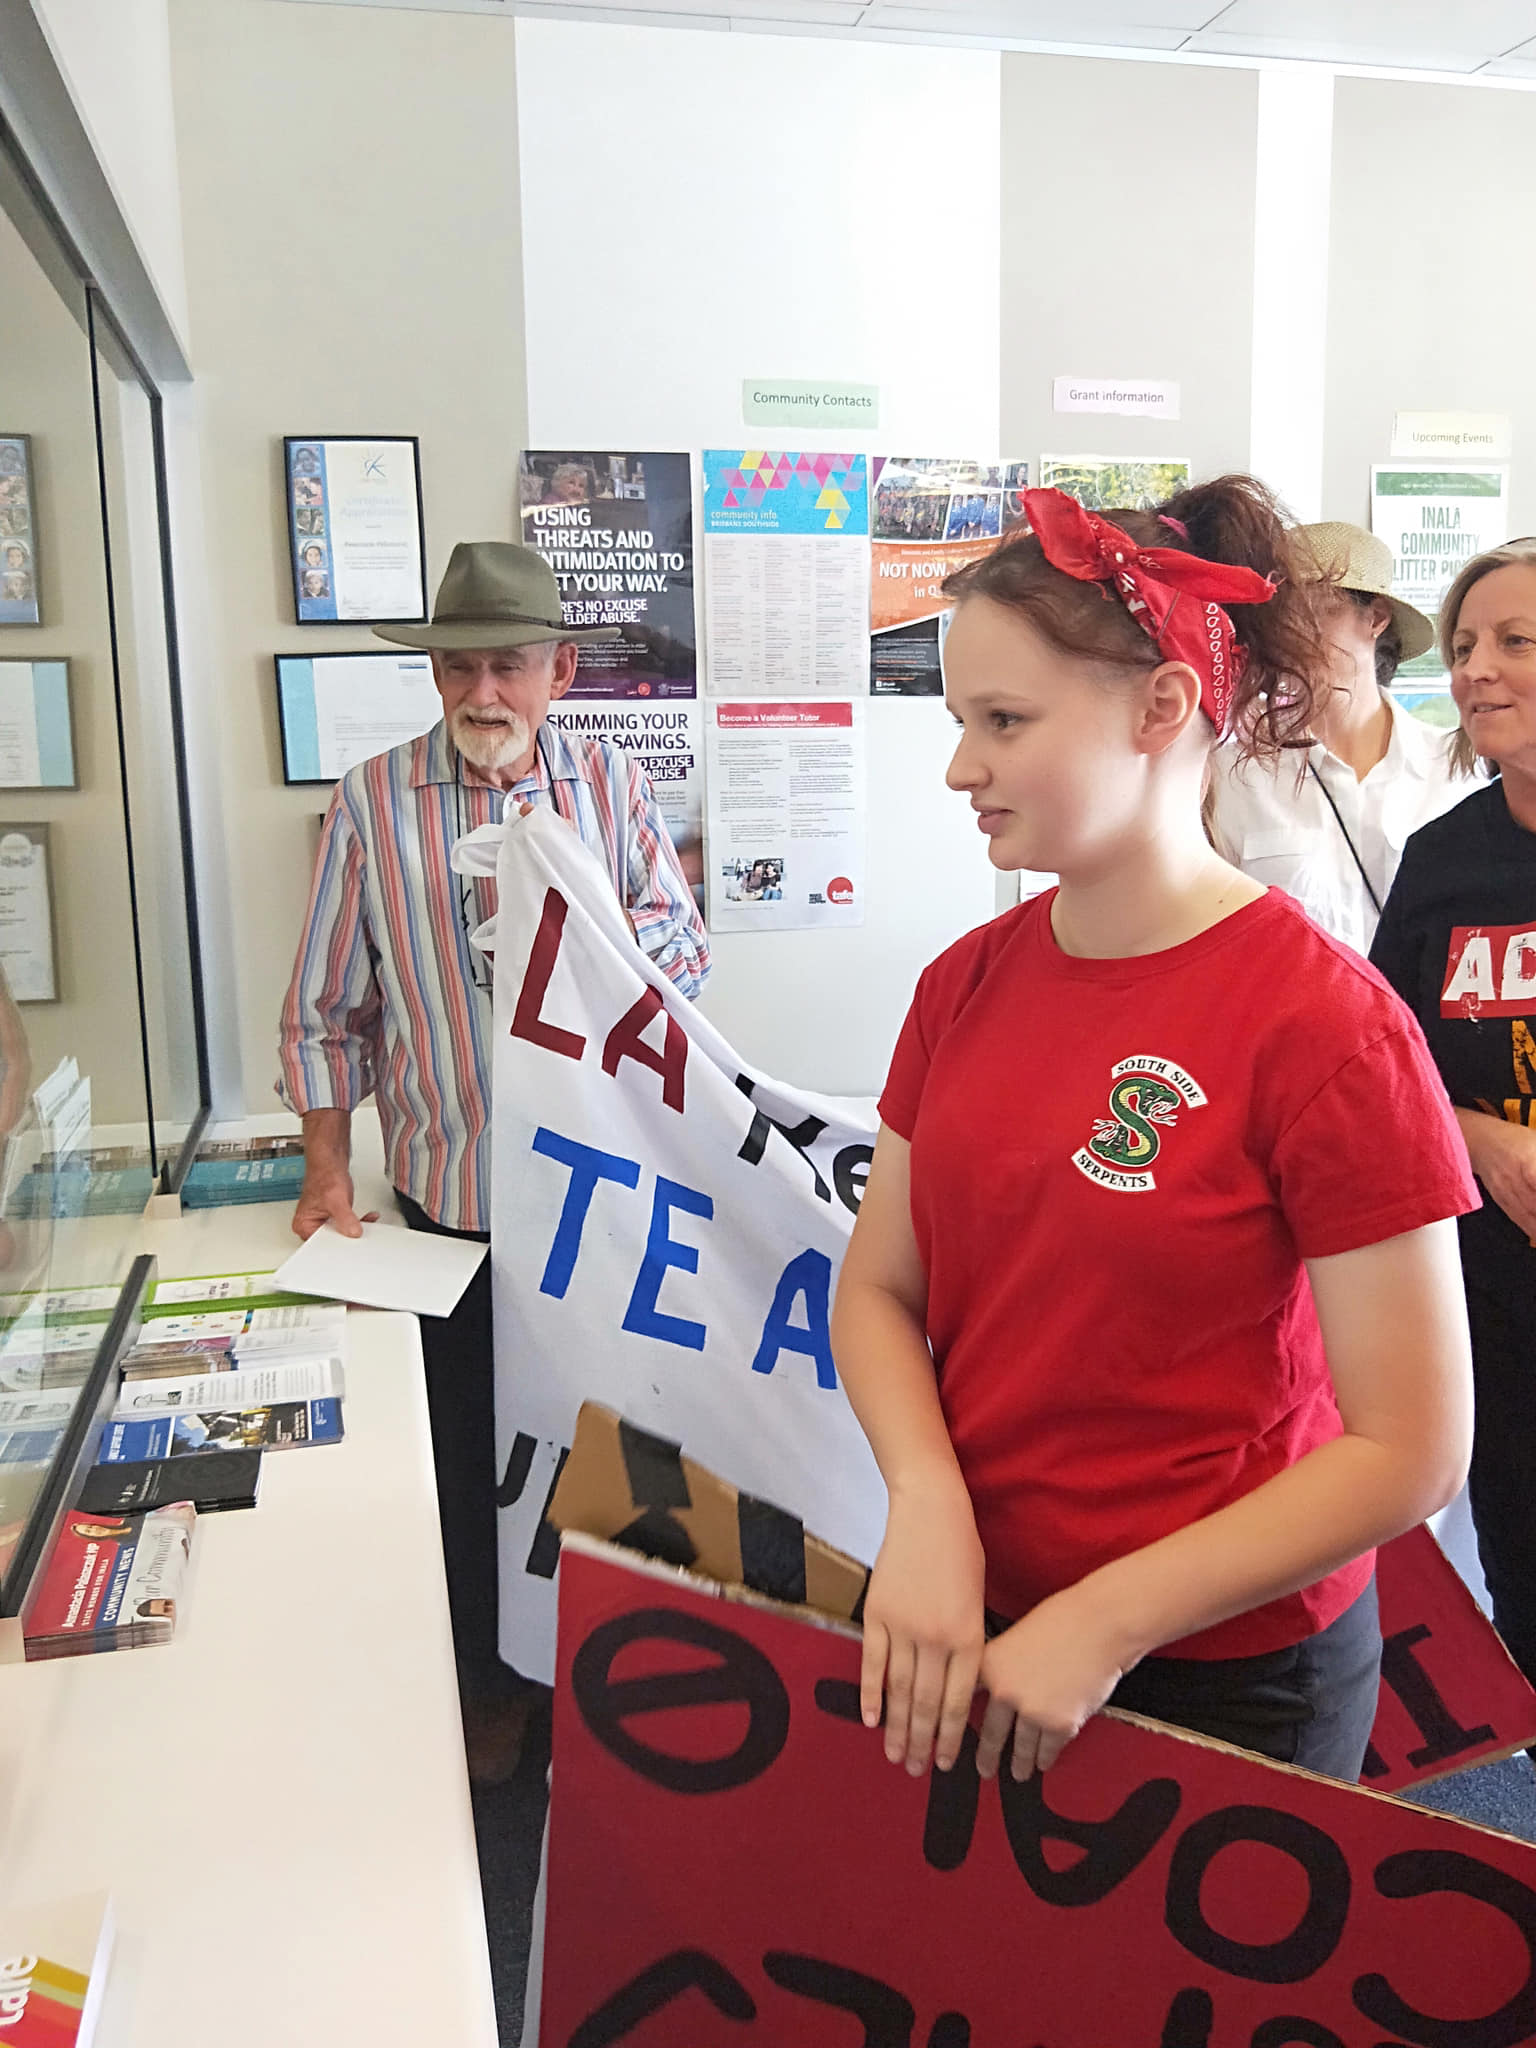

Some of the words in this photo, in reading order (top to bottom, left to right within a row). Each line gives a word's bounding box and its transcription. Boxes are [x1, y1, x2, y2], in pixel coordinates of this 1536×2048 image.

[753, 391, 820, 407] Community
[823, 394, 872, 407] Contacts
[1069, 389, 1099, 401] Grant
[1102, 390, 1164, 403] information
[1412, 431, 1460, 445] Upcoming
[1463, 432, 1494, 443] Events
[533, 507, 592, 526] USING
[711, 511, 758, 521] community
[761, 509, 777, 520] info
[1421, 506, 1461, 529] INALA
[533, 529, 614, 549] THREATS
[616, 530, 654, 549] AND
[1401, 532, 1481, 556] COMMUNITY
[536, 552, 658, 571] NTIMIDATION
[660, 553, 685, 571] TO
[879, 562, 909, 578] NOT
[572, 574, 626, 592] YOUR
[626, 574, 668, 592] WAY.
[585, 601, 603, 612] NO
[605, 599, 648, 612] EXCUSE
[564, 613, 599, 624] ELDER
[600, 611, 641, 624] ABUSE.
[546, 714, 638, 730] SKIMMING
[641, 713, 689, 730] YOUR
[719, 714, 752, 722] Become
[800, 713, 820, 721] Tutor
[612, 733, 691, 750] SAVINGS.
[650, 757, 693, 769] EXCUSE
[1117, 1059, 1168, 1074] SOUTH
[1170, 1071, 1201, 1102] SIDE
[1077, 1154, 1148, 1188] SERPENTS
[136, 1528, 175, 1582] Community
[98, 1559, 109, 1575] INALA
[94, 1575, 104, 1586] FOR
[103, 1572, 129, 1622] COMMUNITY
[118, 1546, 136, 1571] NEWS
[86, 1586, 101, 1608] MEMBER
[81, 1609, 94, 1626] STATE
